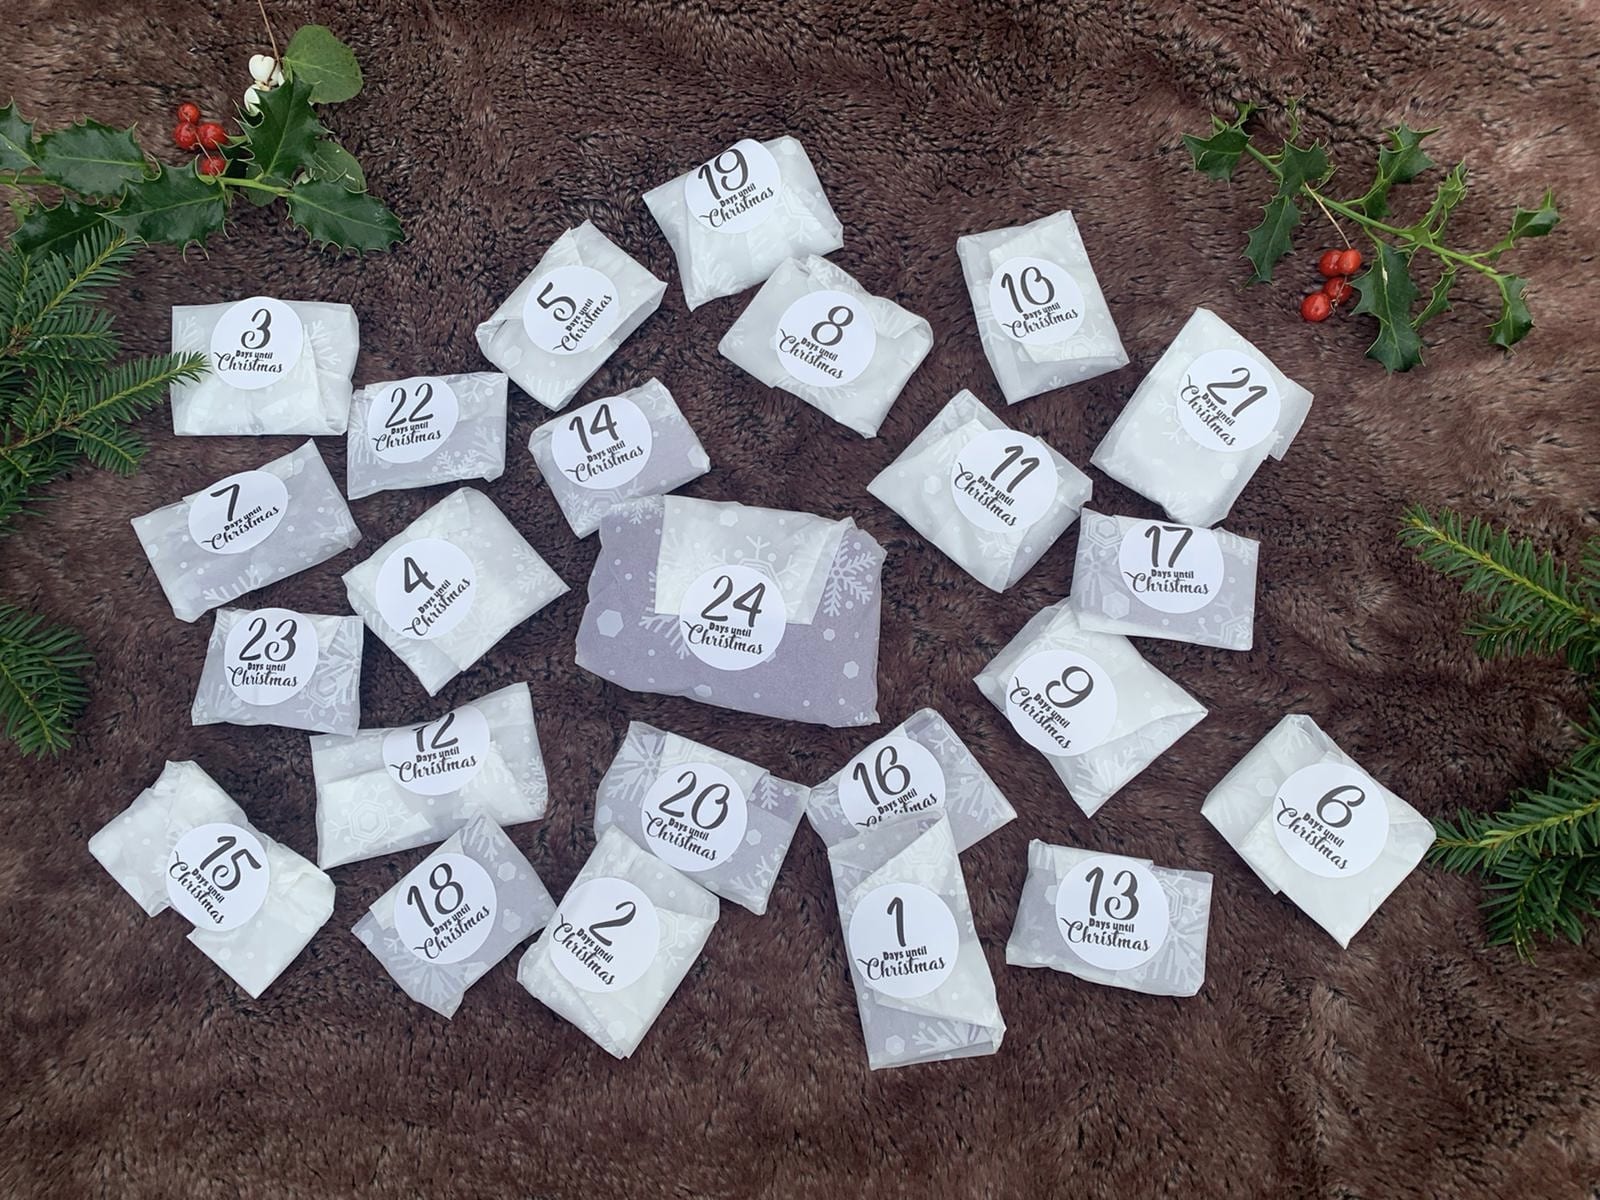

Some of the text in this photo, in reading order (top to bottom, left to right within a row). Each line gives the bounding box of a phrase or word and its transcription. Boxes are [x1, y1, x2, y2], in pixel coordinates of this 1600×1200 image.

[698, 148, 748, 200] 19
[700, 187, 773, 229] Christmas
[719, 183, 756, 208] Days until
[537, 282, 576, 322] 5
[1001, 266, 1054, 313] 10
[241, 309, 272, 349] 3
[553, 294, 612, 352] Christmas
[565, 298, 594, 331] Days until
[812, 306, 853, 346] 8
[1002, 305, 1078, 338] Christmas
[1023, 303, 1061, 321] Days until
[214, 351, 283, 374] Christmas
[236, 349, 273, 359] Days until
[780, 328, 843, 379] Christmas
[801, 337, 838, 361] Days until
[385, 383, 433, 428] 22
[1180, 375, 1235, 446] Christmas
[1202, 393, 1235, 426] Days until
[1206, 368, 1267, 417] 21
[372, 424, 442, 452] Christmas
[391, 422, 429, 436] Days until
[569, 404, 619, 453] 14
[566, 445, 644, 482] Christmas
[587, 440, 625, 464] Days until
[990, 445, 1040, 493] 11
[210, 484, 240, 521] 7
[954, 462, 1016, 527] Christmas
[978, 476, 1015, 506] Days until
[202, 505, 279, 550] Christmas
[224, 506, 262, 531] Days until
[1144, 526, 1193, 568] 17
[404, 557, 435, 594] 4
[1124, 570, 1210, 594] Christmas
[1151, 569, 1194, 580] Days until
[403, 577, 471, 636] Christmas
[418, 579, 451, 615] Days until
[701, 576, 765, 628] 24
[239, 618, 297, 662] 23
[683, 620, 764, 655] Christmas
[709, 622, 751, 637] Days until
[227, 665, 298, 687] Christmas
[248, 662, 285, 672] Days until
[1046, 666, 1094, 708] 9
[1010, 677, 1072, 749] Christmas
[1033, 694, 1071, 729] Days until
[412, 712, 458, 752] 12
[390, 755, 478, 783] Christmas
[416, 746, 460, 764] Days until
[853, 746, 910, 805] 16
[658, 771, 730, 830] 20
[877, 788, 917, 815] Days until
[1316, 784, 1365, 828] 6
[644, 811, 717, 861] Christmas
[668, 818, 709, 841] Days until
[1277, 797, 1348, 870] Christmas
[1302, 812, 1344, 847] Days until
[199, 836, 262, 891] 15
[169, 852, 224, 924] Christmas
[191, 868, 224, 904] Days until
[407, 863, 464, 927] 18
[1085, 866, 1139, 920] 13
[414, 905, 490, 959] Christmas
[434, 904, 470, 935] Days until
[589, 901, 636, 946] 2
[887, 896, 906, 947] 1
[1060, 917, 1150, 951] Christmas
[1089, 917, 1134, 932] Days until
[553, 913, 615, 985] Christmas
[576, 927, 614, 963] Days until
[883, 946, 927, 961] Days until
[857, 956, 945, 980] Christmas
